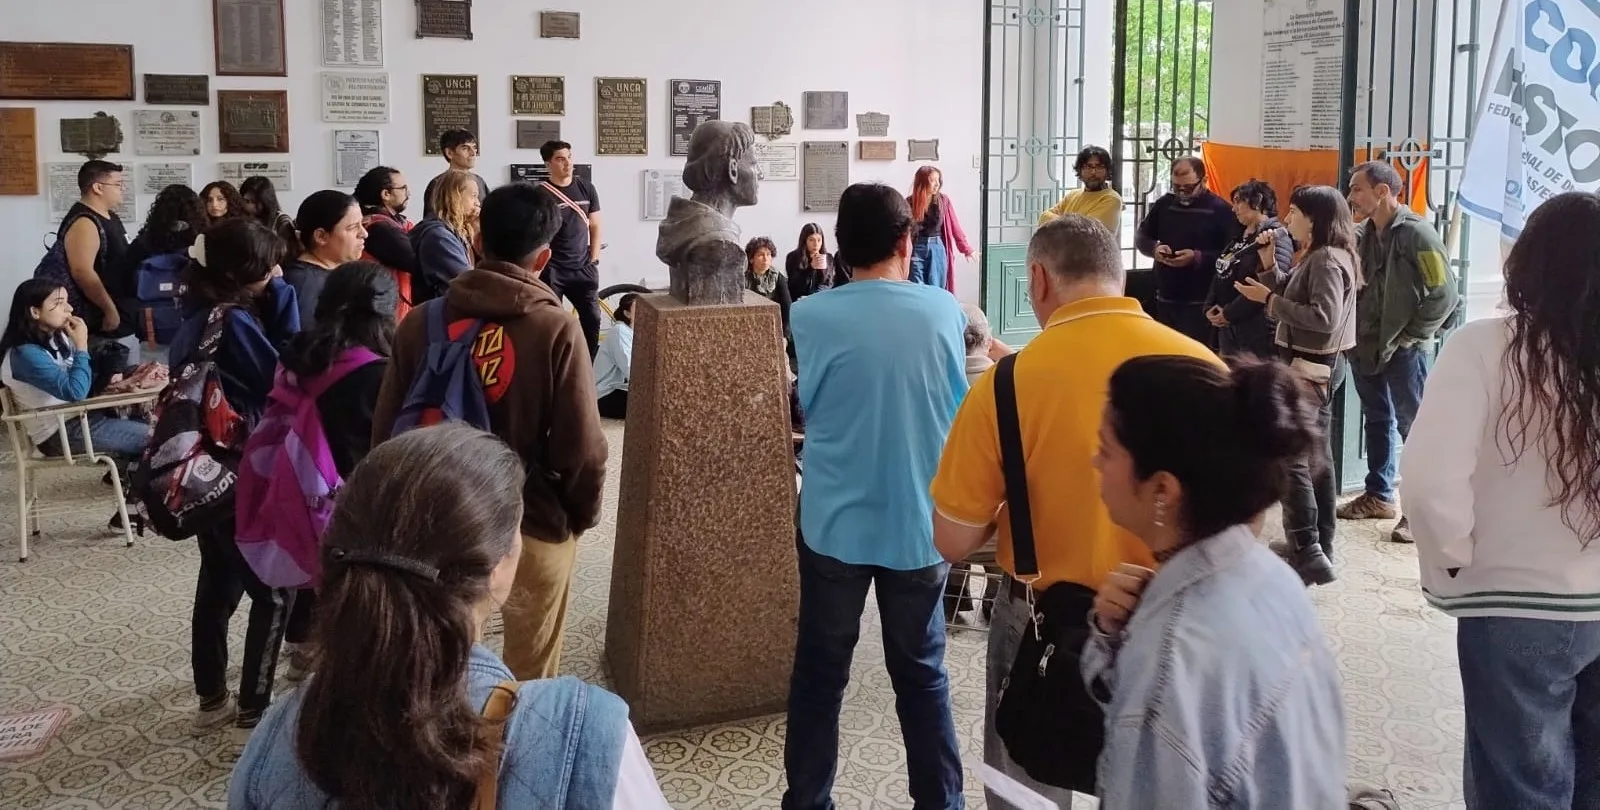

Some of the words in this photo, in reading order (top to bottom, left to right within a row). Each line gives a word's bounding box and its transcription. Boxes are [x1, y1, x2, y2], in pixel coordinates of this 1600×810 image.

[445, 78, 472, 89] UNCA
[616, 83, 641, 93] UNCA
[1543, 166, 1564, 184] DE
